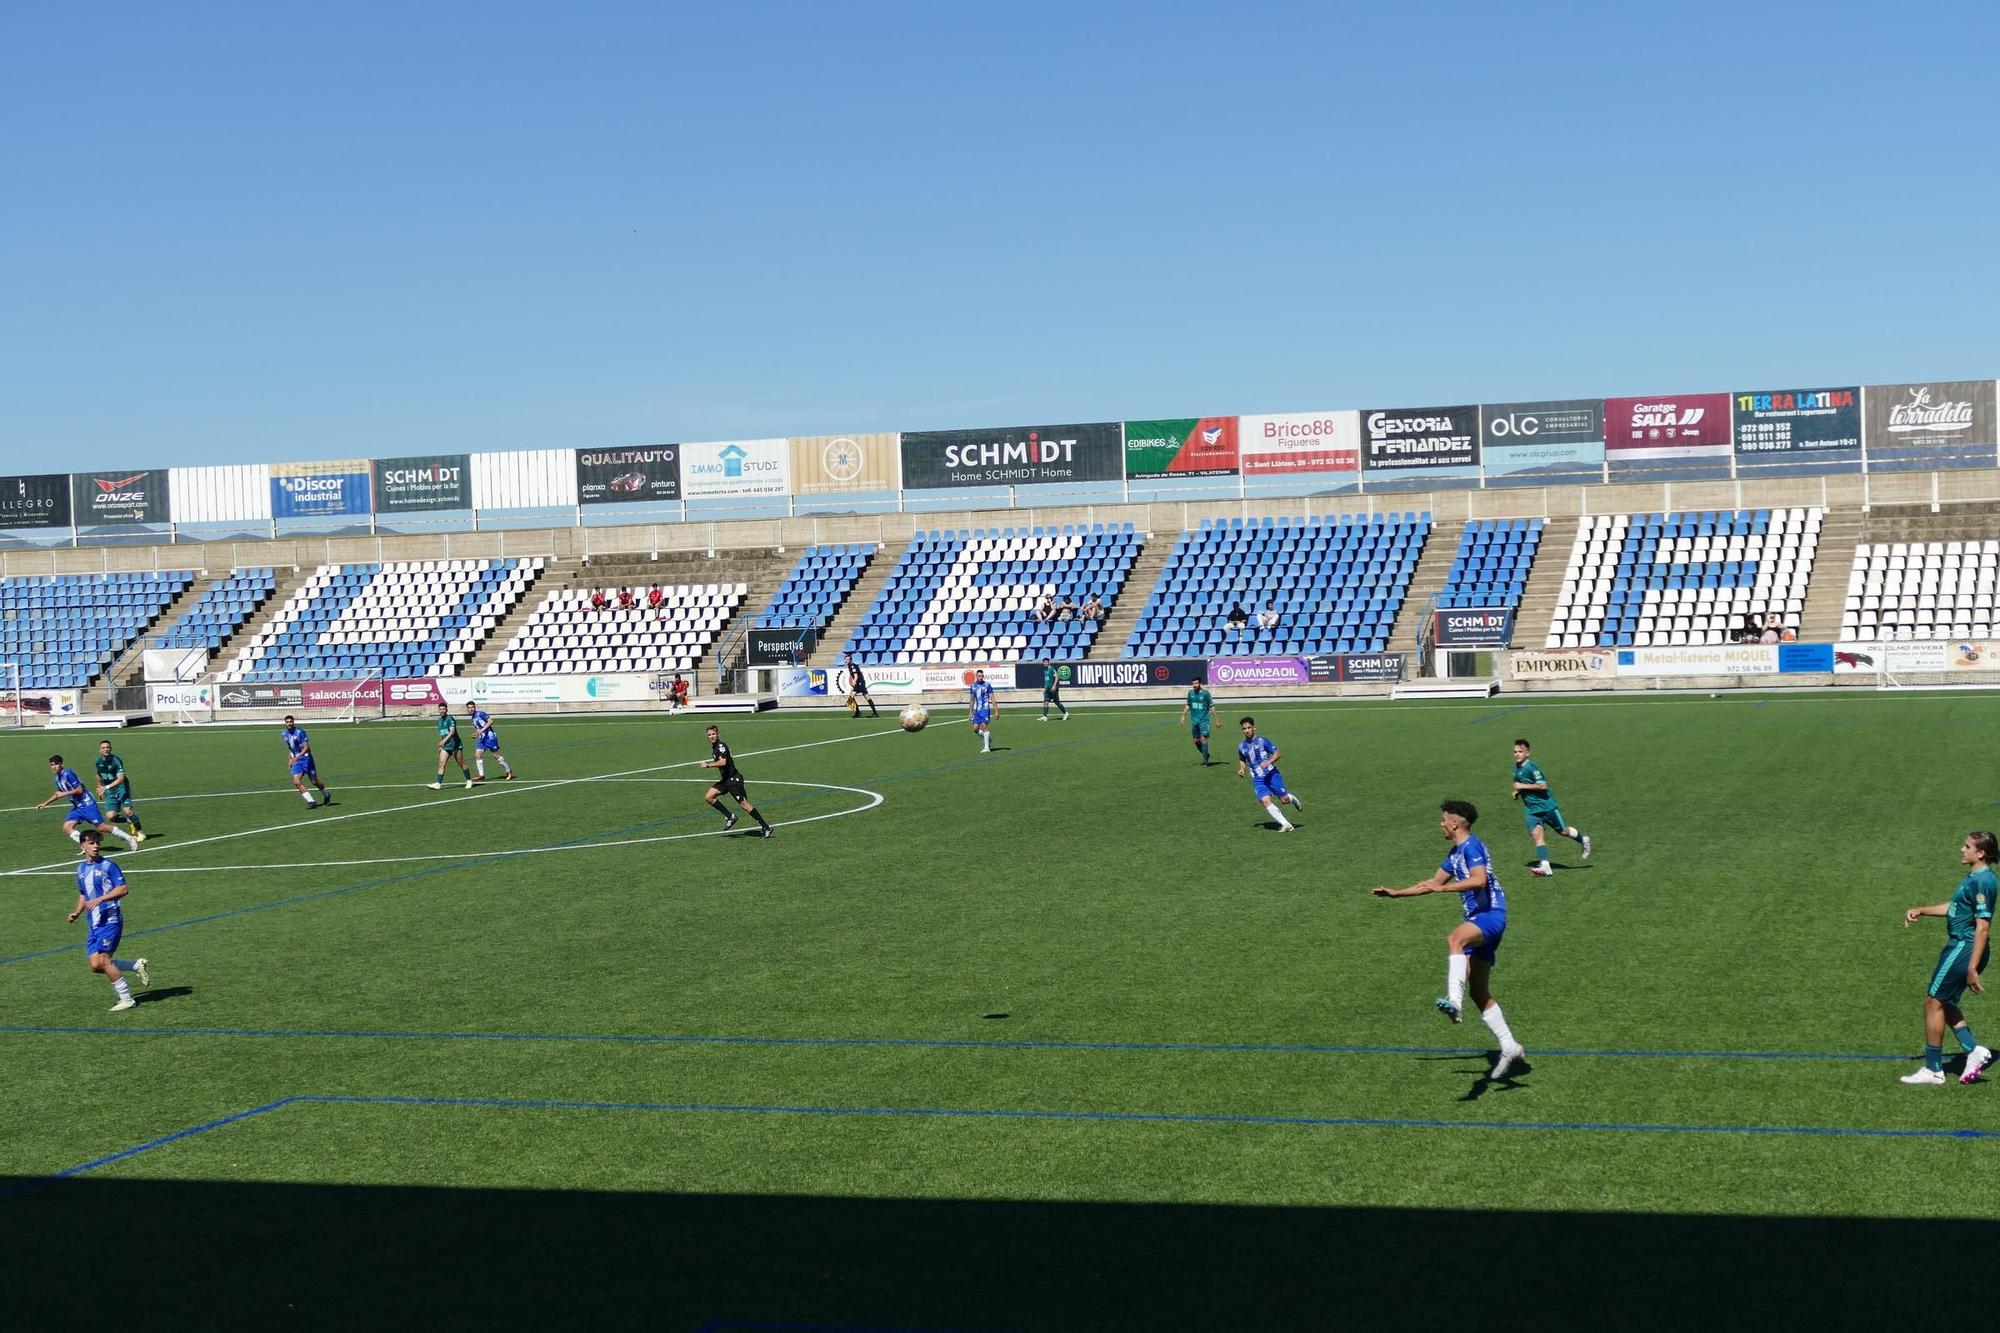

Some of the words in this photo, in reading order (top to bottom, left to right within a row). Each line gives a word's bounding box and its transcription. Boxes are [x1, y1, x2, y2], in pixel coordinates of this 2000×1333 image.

[1737, 394, 1795, 411] TIERRA
[1797, 391, 1854, 408] LATINA
[1909, 387, 1931, 408] La
[1634, 403, 1677, 413] Garatge
[1491, 413, 1539, 436] olc
[1631, 413, 1677, 427] SALA
[1264, 420, 1334, 438] Brico88
[1128, 438, 1166, 448] EDIBIKES
[1278, 438, 1321, 449] Figueres
[581, 450, 674, 466] QUALITAUTO
[691, 464, 723, 474] IMMO
[743, 461, 778, 472] STUDI
[952, 471, 982, 482] Home
[985, 468, 1037, 481] SCHMIDT
[1041, 468, 1072, 478] Home
[294, 477, 344, 492] Discor
[582, 484, 606, 493] planxa
[651, 481, 675, 490] pintura
[96, 492, 145, 502] ONZE
[295, 490, 342, 502] industrial
[2, 499, 54, 509] LLEGRO
[758, 640, 804, 653] Perspective
[1725, 650, 1772, 662] MIQUEL
[1348, 658, 1399, 669] SCHMDT
[867, 671, 910, 682] ARDELL
[925, 675, 956, 683] ENGLISH
[1077, 664, 1148, 685] IMPULSO23
[157, 693, 197, 706] ProLiga
